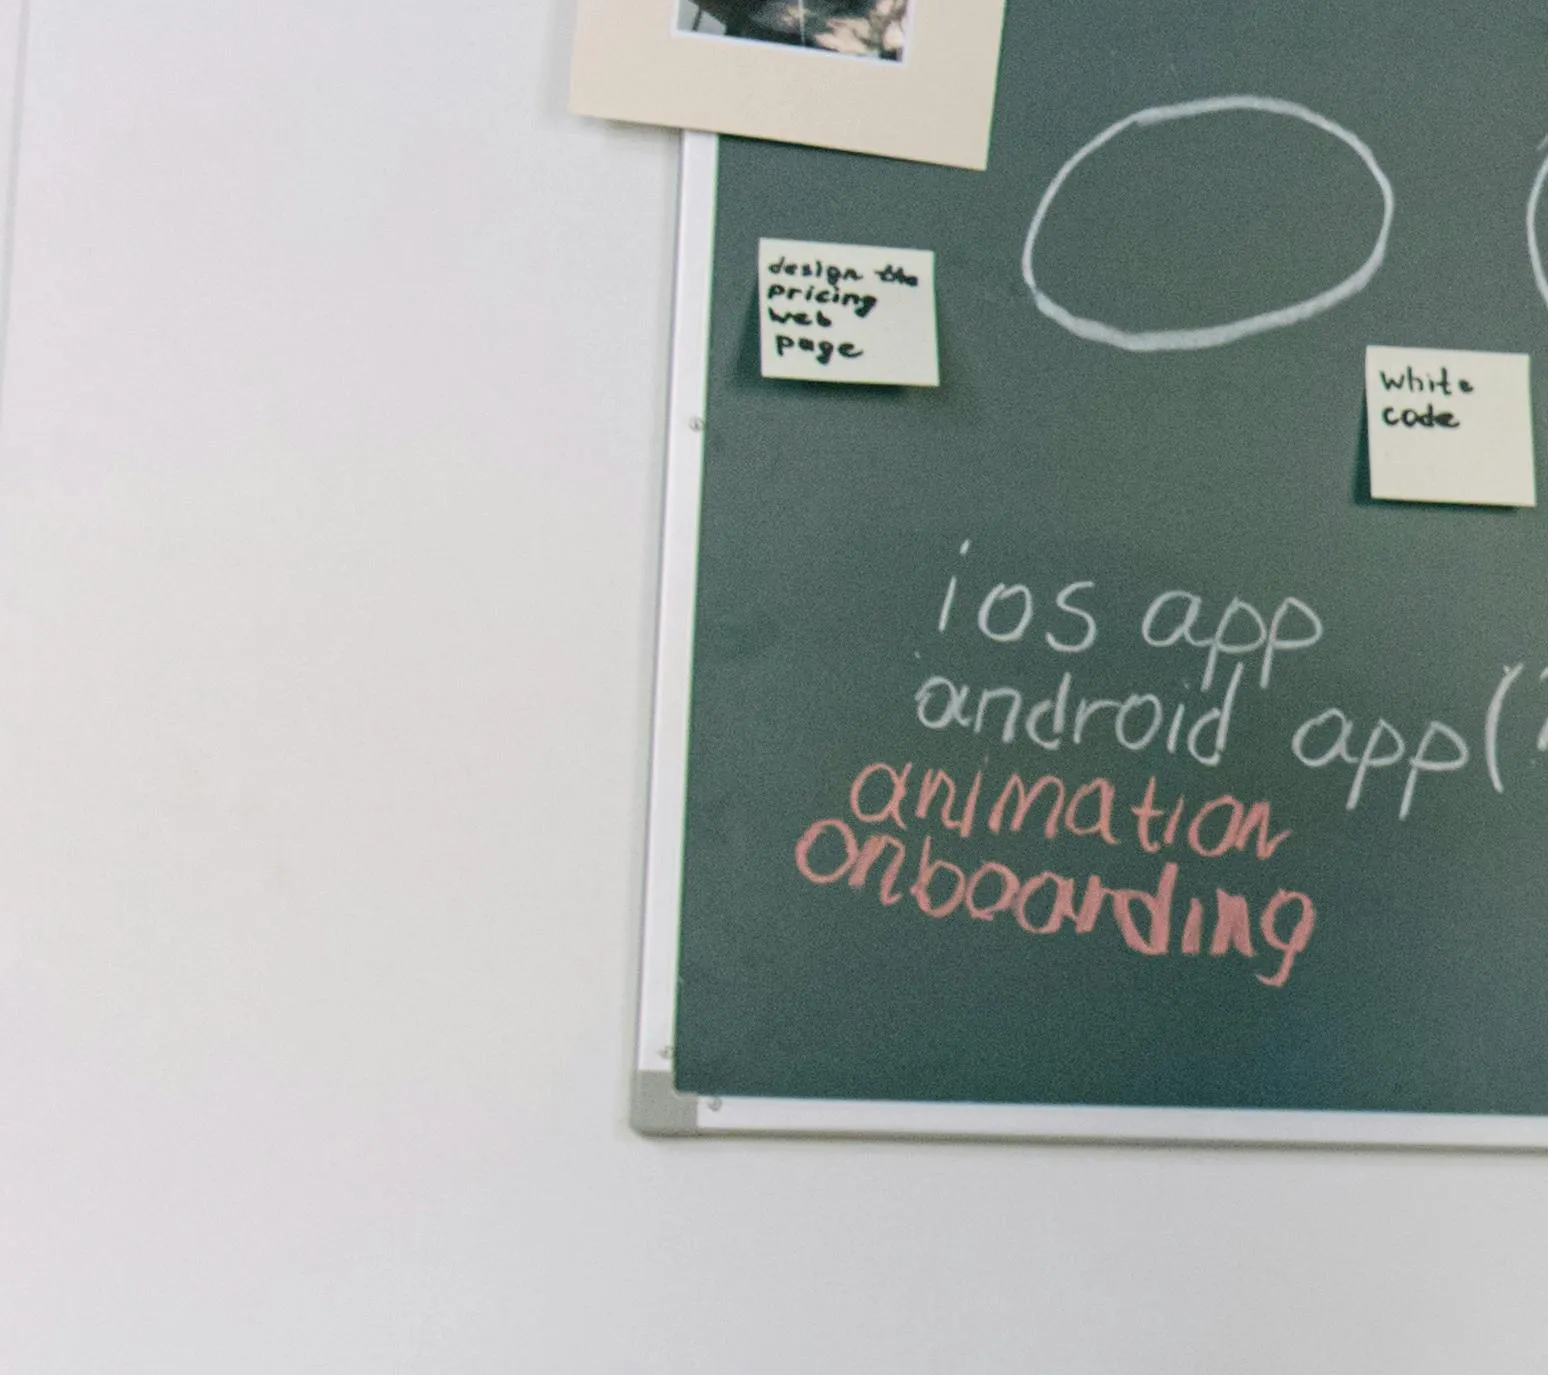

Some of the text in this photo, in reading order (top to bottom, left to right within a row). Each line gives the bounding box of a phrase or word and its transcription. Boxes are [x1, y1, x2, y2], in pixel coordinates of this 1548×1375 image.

[768, 256, 919, 287] design the
[767, 284, 878, 318] pricing
[768, 307, 833, 328] web
[776, 334, 864, 365] page
[1379, 365, 1475, 395] white
[1382, 402, 1461, 428] code
[1142, 589, 1325, 690] app
[913, 660, 1245, 766] android
[849, 756, 1291, 861] animation
[795, 817, 1317, 987] onboarding
